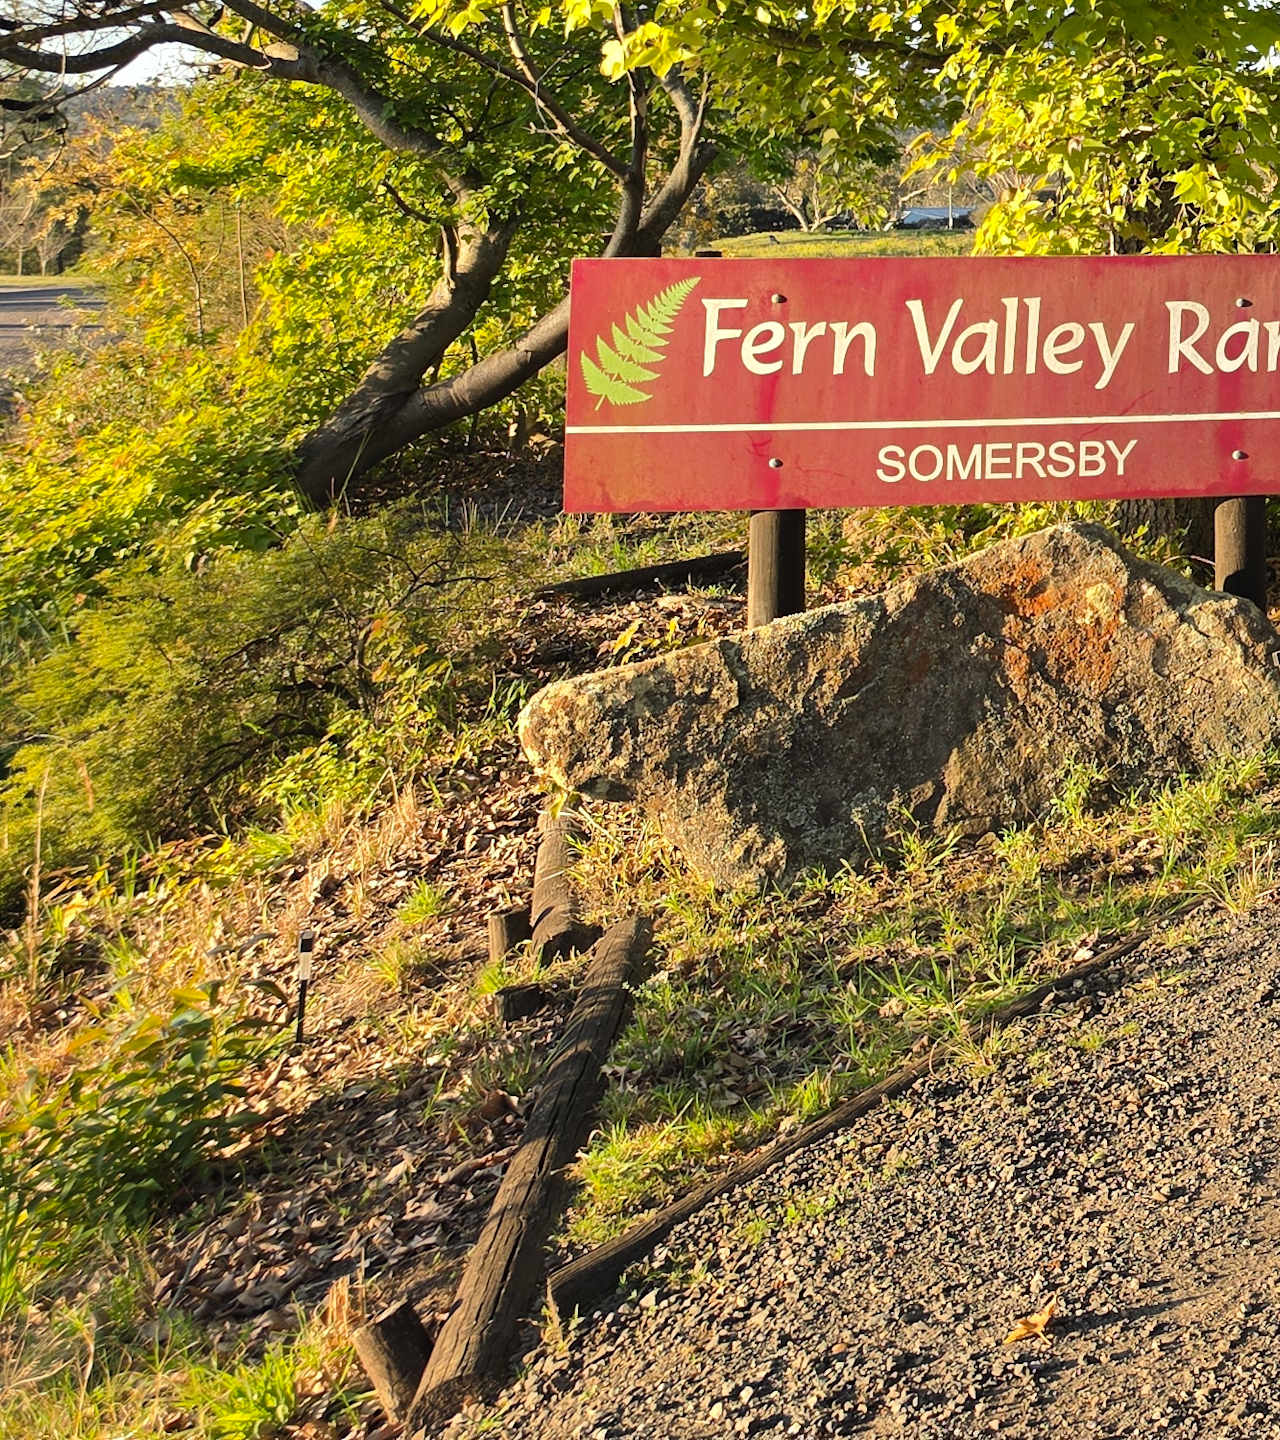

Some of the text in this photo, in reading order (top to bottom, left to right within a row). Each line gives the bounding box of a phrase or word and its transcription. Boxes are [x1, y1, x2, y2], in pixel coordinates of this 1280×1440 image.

[701, 297, 877, 377] Fern
[904, 296, 1136, 390] Valley
[875, 439, 1139, 483] SOMERSBY
